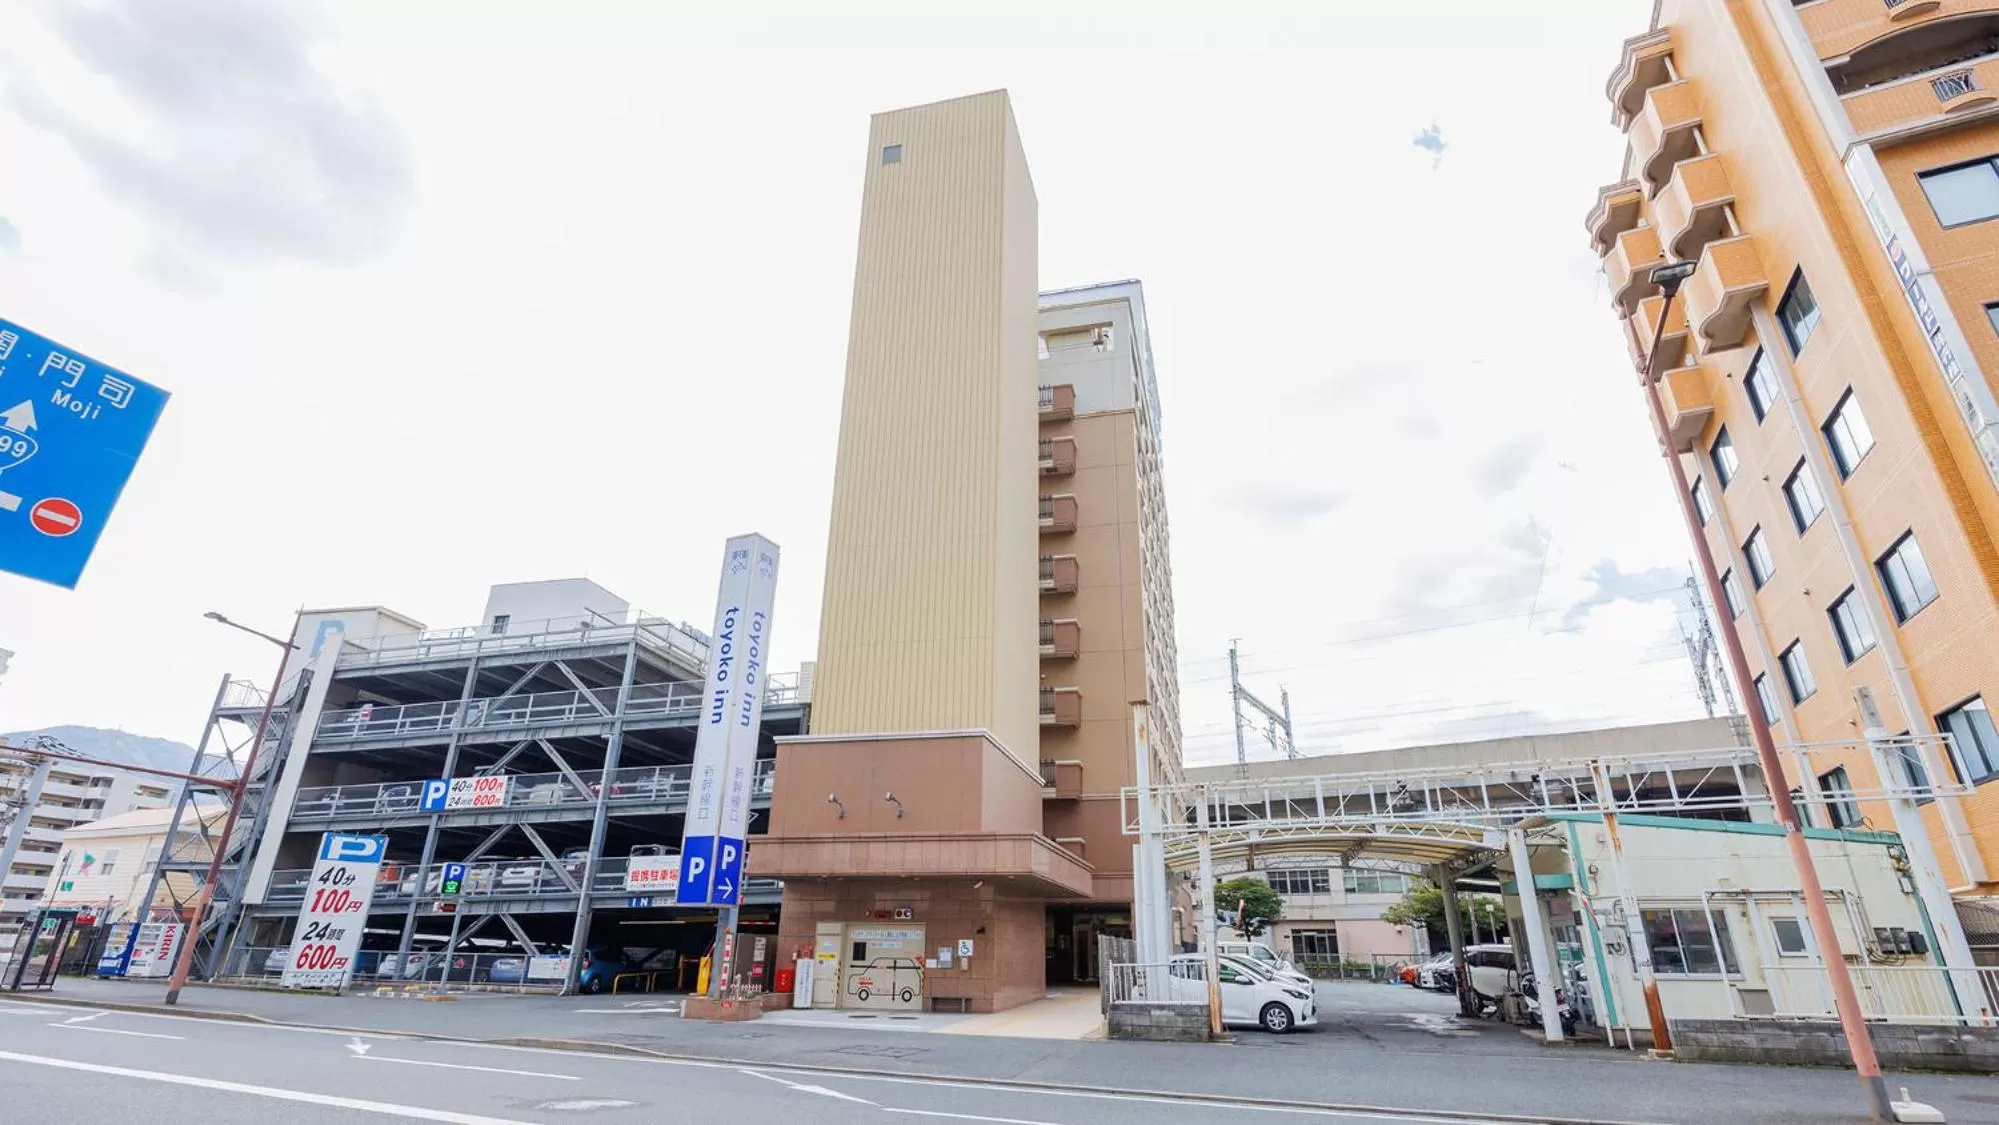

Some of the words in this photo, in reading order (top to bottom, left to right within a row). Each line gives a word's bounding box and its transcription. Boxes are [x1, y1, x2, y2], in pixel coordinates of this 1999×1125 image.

[51, 389, 102, 419] Moji
[717, 606, 740, 683] toyoko
[745, 610, 766, 685] toyoko
[711, 690, 729, 724] inn
[740, 692, 757, 727] inn
[425, 781, 447, 809] P
[328, 837, 378, 859] P
[721, 844, 736, 870] P
[318, 866, 356, 886] 40分
[449, 865, 462, 879] P
[687, 857, 705, 883] P
[310, 888, 363, 914] 100円
[158, 925, 177, 961] KIRIN
[301, 921, 345, 942] 24時間
[296, 944, 348, 970] 600円
